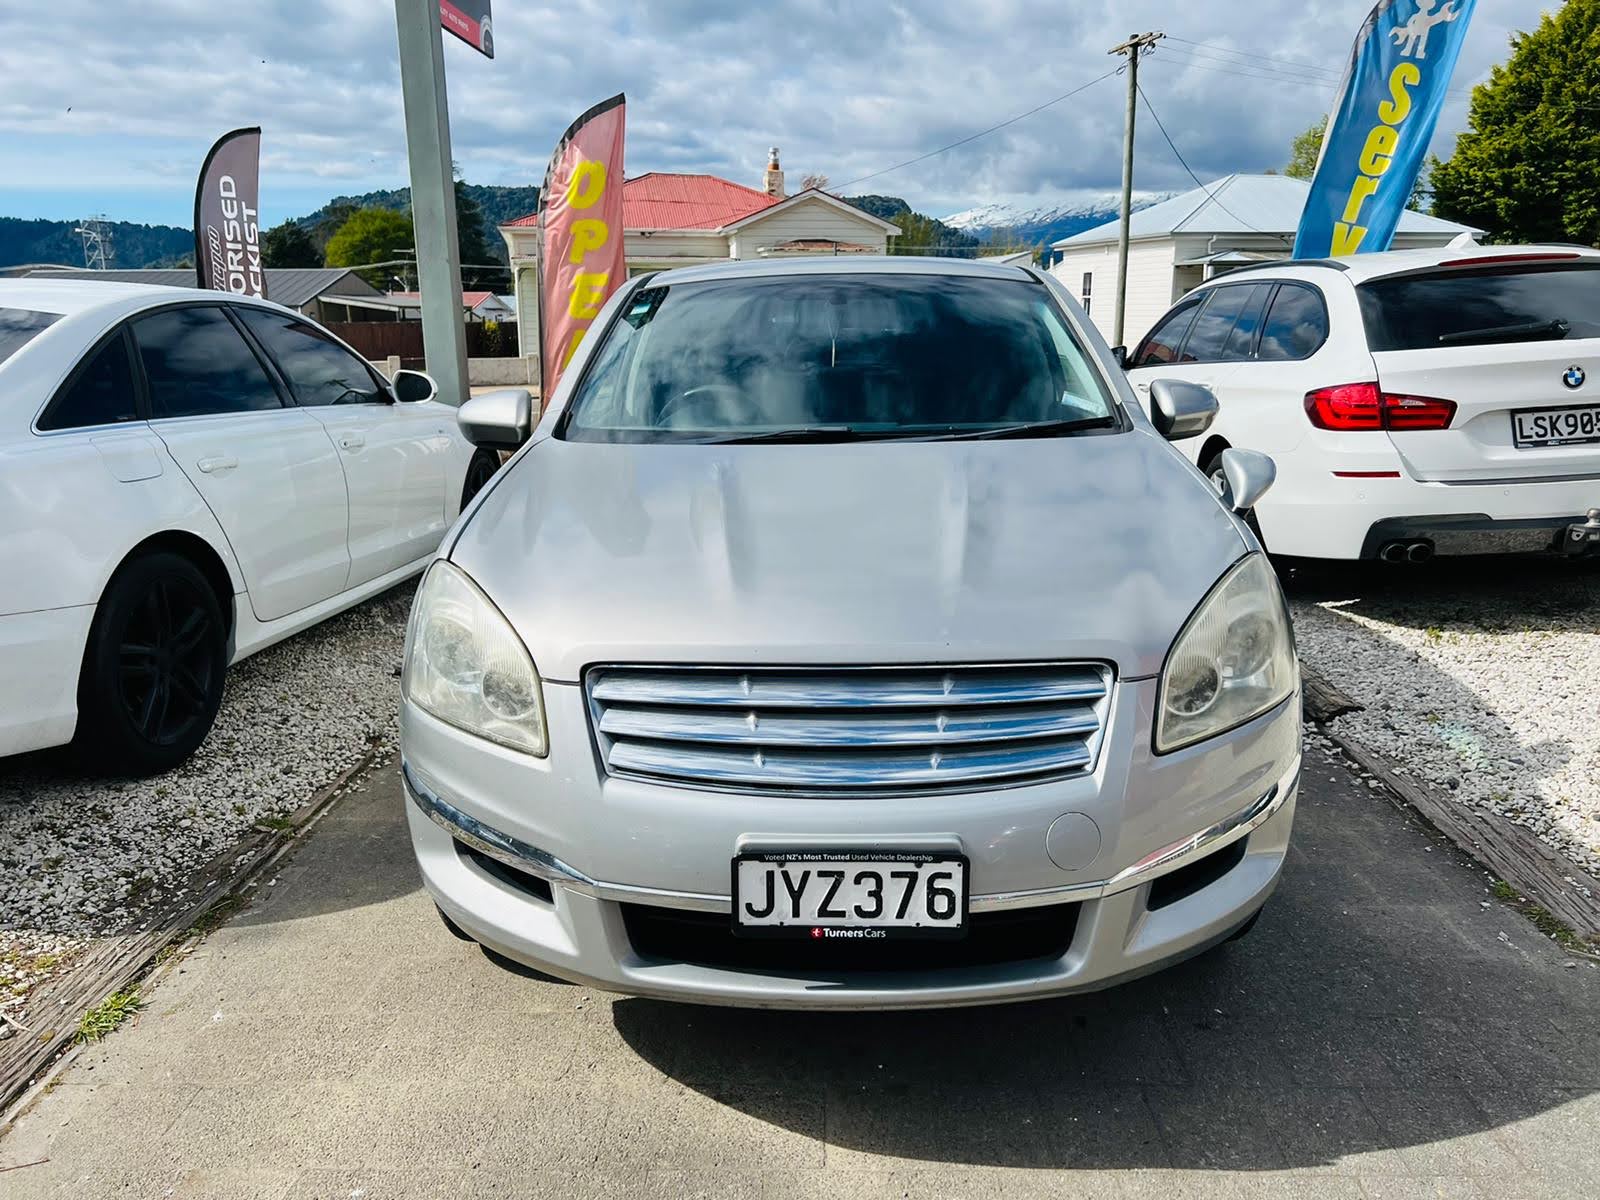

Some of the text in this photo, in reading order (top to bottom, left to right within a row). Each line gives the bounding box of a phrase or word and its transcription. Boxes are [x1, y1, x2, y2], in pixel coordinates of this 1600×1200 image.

[764, 853, 934, 862] Voted NZ's Most Trusted Used Vehicle Dealership
[745, 870, 956, 920] JYZ376
